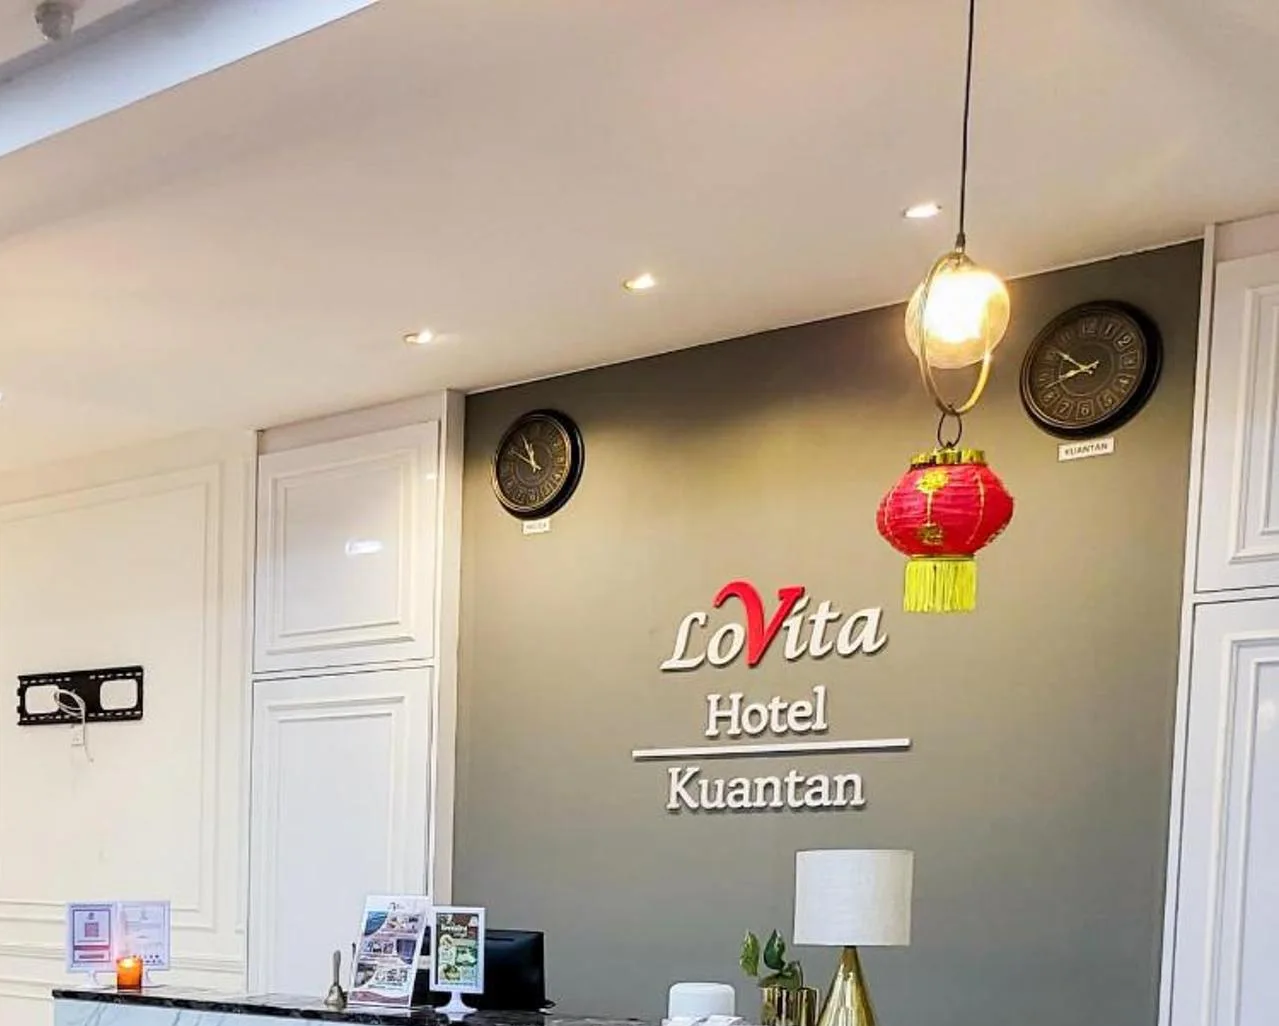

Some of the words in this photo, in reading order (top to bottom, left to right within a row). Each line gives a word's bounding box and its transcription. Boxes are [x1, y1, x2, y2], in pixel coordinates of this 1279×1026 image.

[659, 578, 888, 671] LoVita
[705, 685, 827, 736] Hotel
[666, 766, 866, 810] Kuantan
